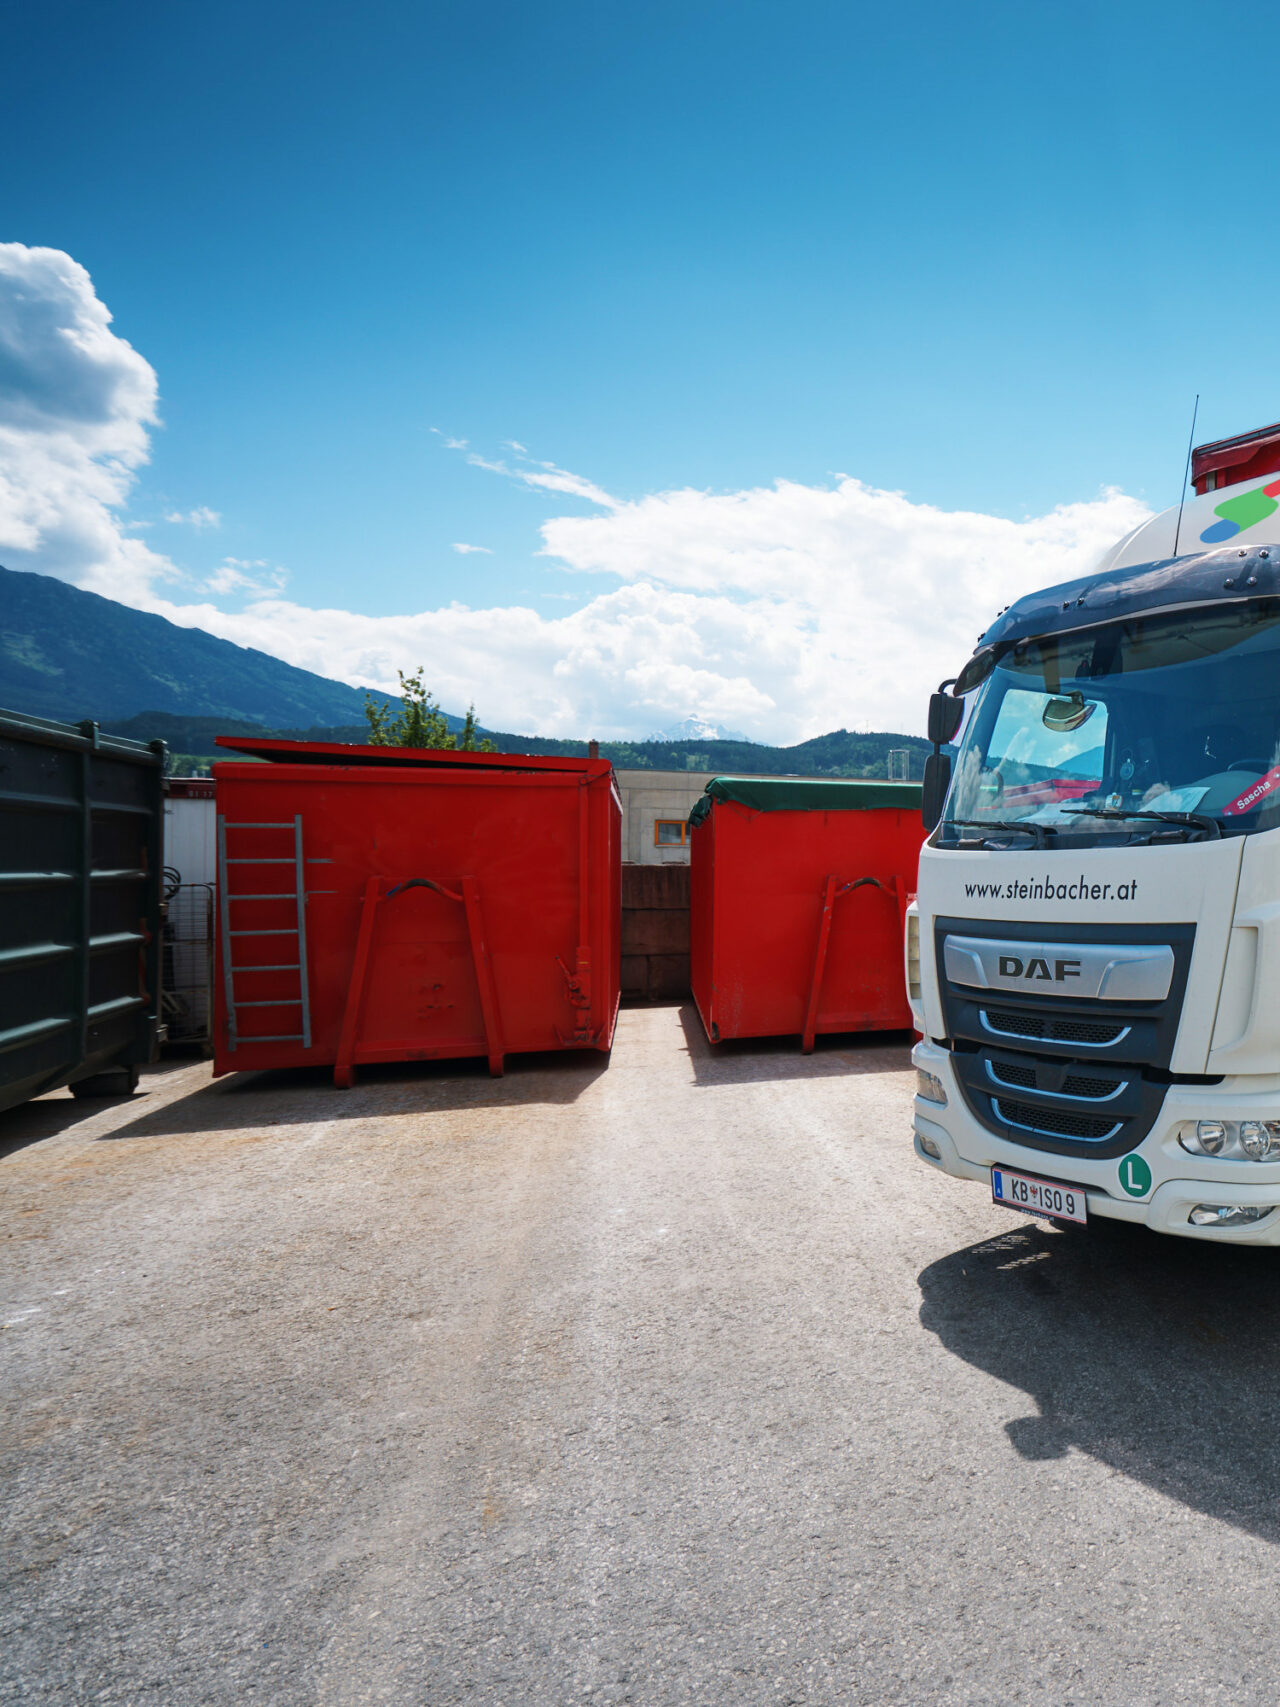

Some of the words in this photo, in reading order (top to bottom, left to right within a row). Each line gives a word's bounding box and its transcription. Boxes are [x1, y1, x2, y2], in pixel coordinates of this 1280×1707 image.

[1237, 781, 1271, 809] Sascha
[965, 874, 1138, 901] www.steinbacher.at
[999, 955, 1082, 982] DAF
[1127, 1161, 1143, 1190] L
[1011, 1178, 1028, 1202] KB
